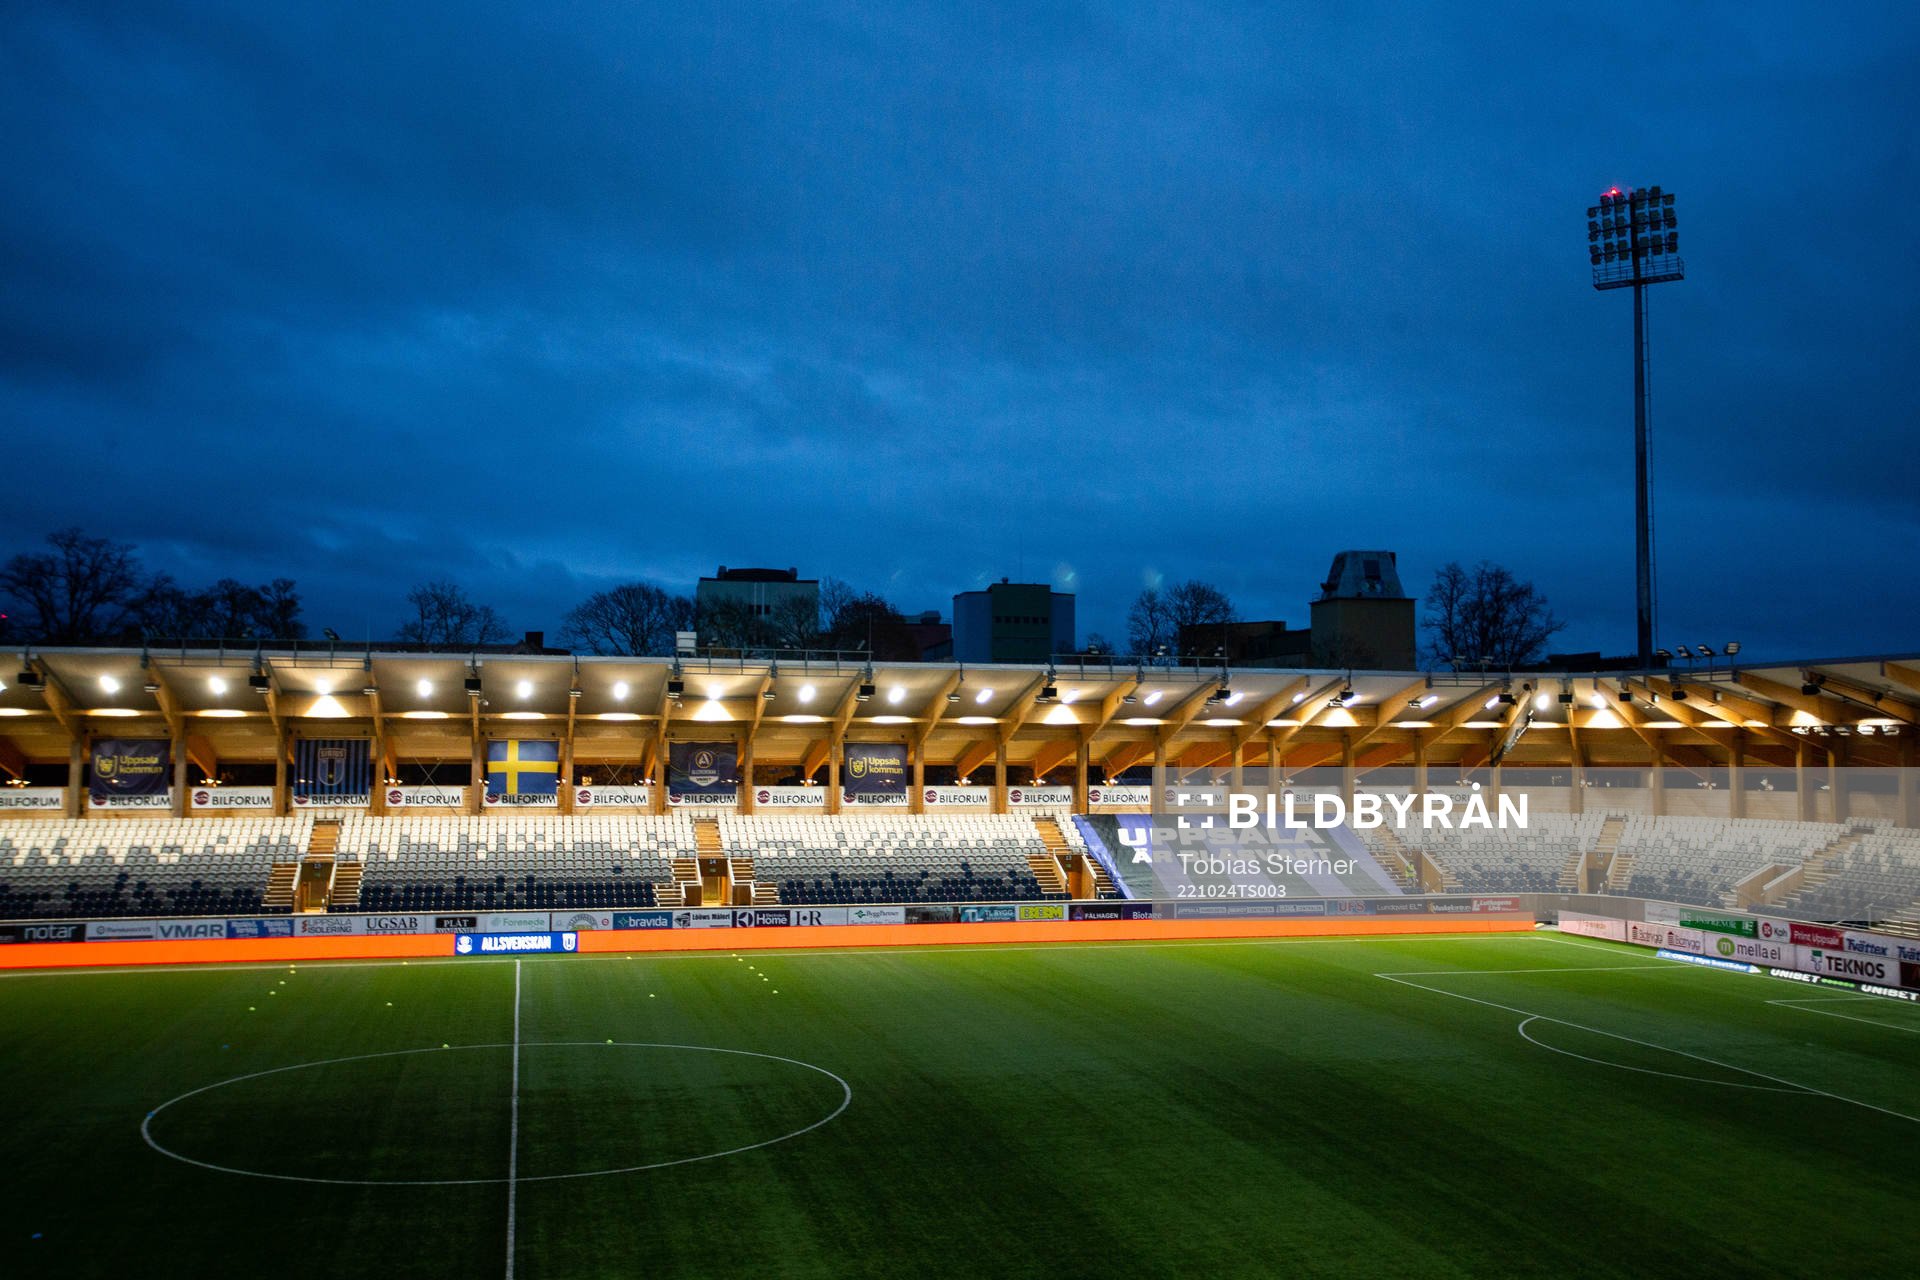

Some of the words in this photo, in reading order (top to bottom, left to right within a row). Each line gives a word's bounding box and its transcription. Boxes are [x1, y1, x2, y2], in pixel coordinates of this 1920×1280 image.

[119, 755, 159, 765] Uppsala
[868, 757, 900, 766] Uppsala
[119, 765, 163, 774] kommun
[869, 766, 904, 774] kommun
[110, 796, 171, 806] BILFORUM
[212, 796, 271, 805] BILFORUM
[312, 795, 369, 805] BILFORUM
[405, 795, 461, 804] BILFORUM
[502, 795, 556, 804] BILFORUM
[594, 795, 647, 804] BILFORUM
[684, 795, 736, 804] BILFORUM
[772, 796, 823, 804] BILFORUM
[858, 796, 907, 804] BILFORUM
[939, 795, 988, 803] BILFORUM
[1024, 795, 1072, 803] BILFORUM
[1103, 794, 1149, 803] BILFORUM
[1117, 827, 1325, 846] UPPSALA
[307, 918, 353, 926] UPPSALA
[366, 917, 418, 929] UGSAB
[443, 917, 469, 928] PLÅT
[628, 916, 668, 927] bravida
[756, 914, 788, 925] Home
[24, 925, 77, 940] notar
[160, 924, 224, 938] VMAR
[307, 926, 353, 934] ISOLERING
[481, 935, 552, 951] ALLSVENSKAN
[1846, 938, 1888, 956] Tvättex
[1826, 956, 1885, 979] TEKNOS
[1770, 968, 1821, 984] UNIBET
[1861, 984, 1920, 1001] UNIBET
